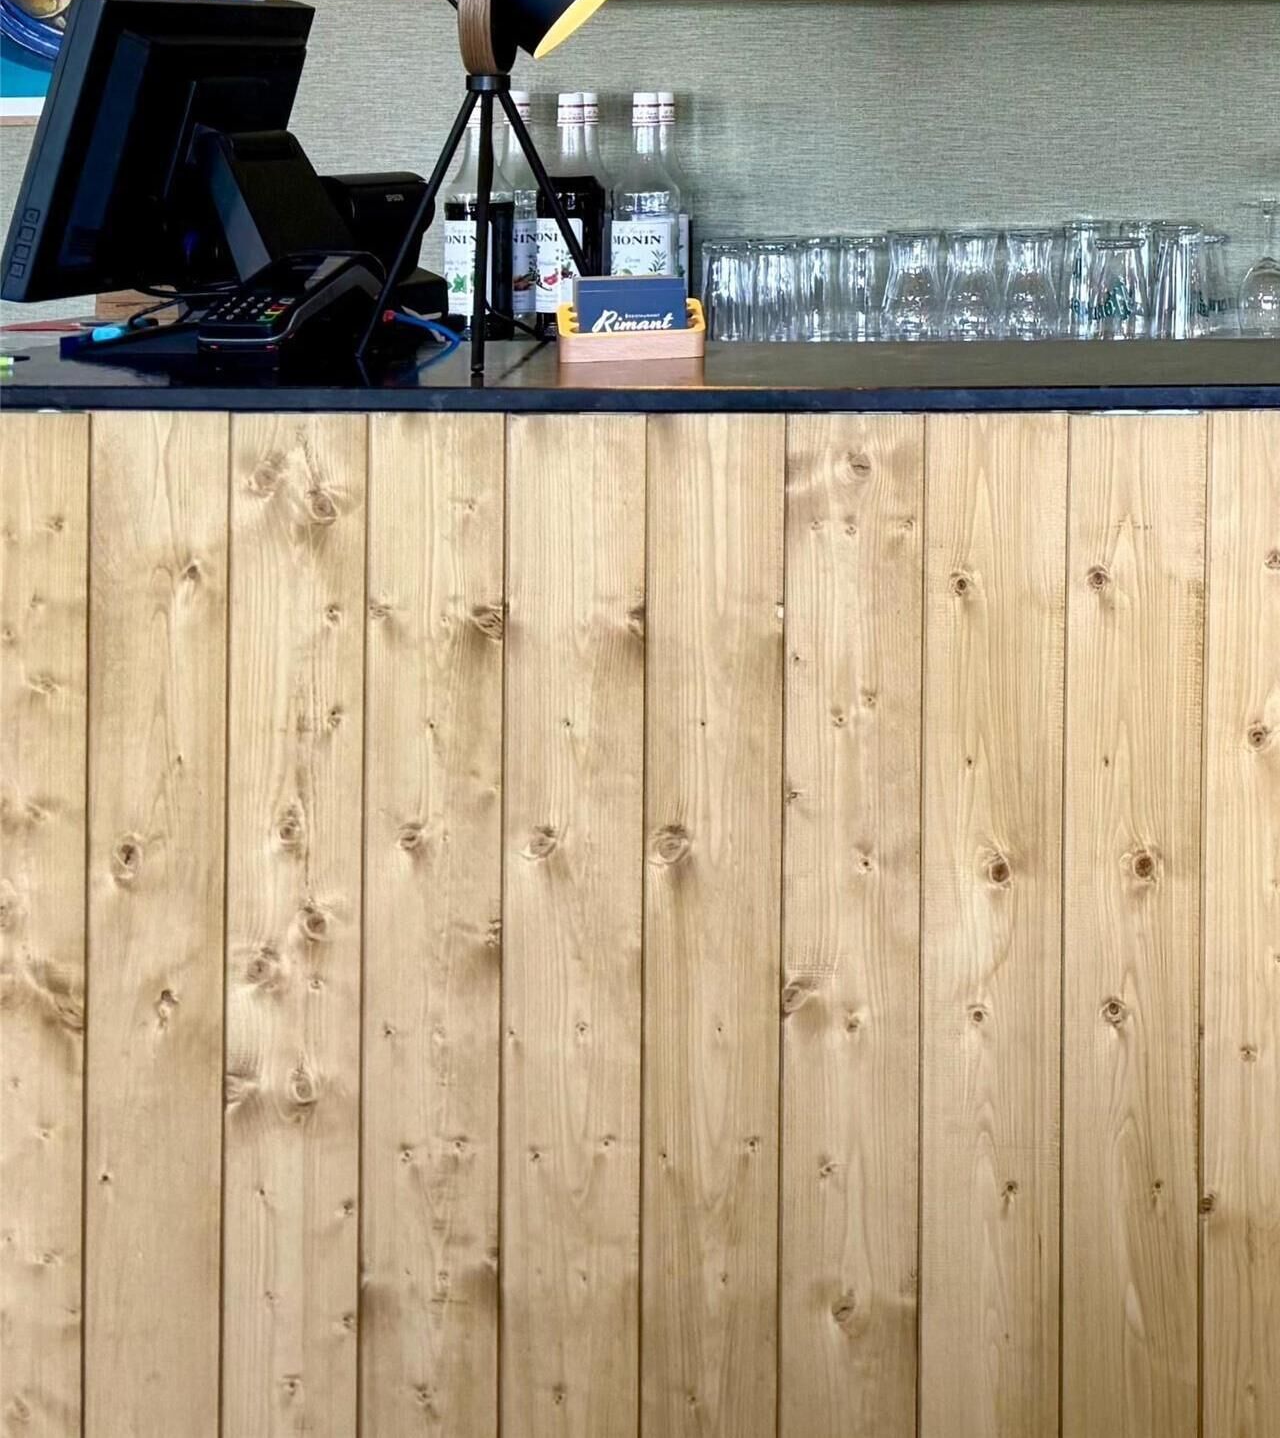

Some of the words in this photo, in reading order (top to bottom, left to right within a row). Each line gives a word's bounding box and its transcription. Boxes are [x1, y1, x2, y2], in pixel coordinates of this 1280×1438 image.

[447, 235, 478, 245] ONIN
[537, 233, 558, 242] ONI
[613, 235, 661, 245] MONIN
[591, 309, 674, 333] Rimant
